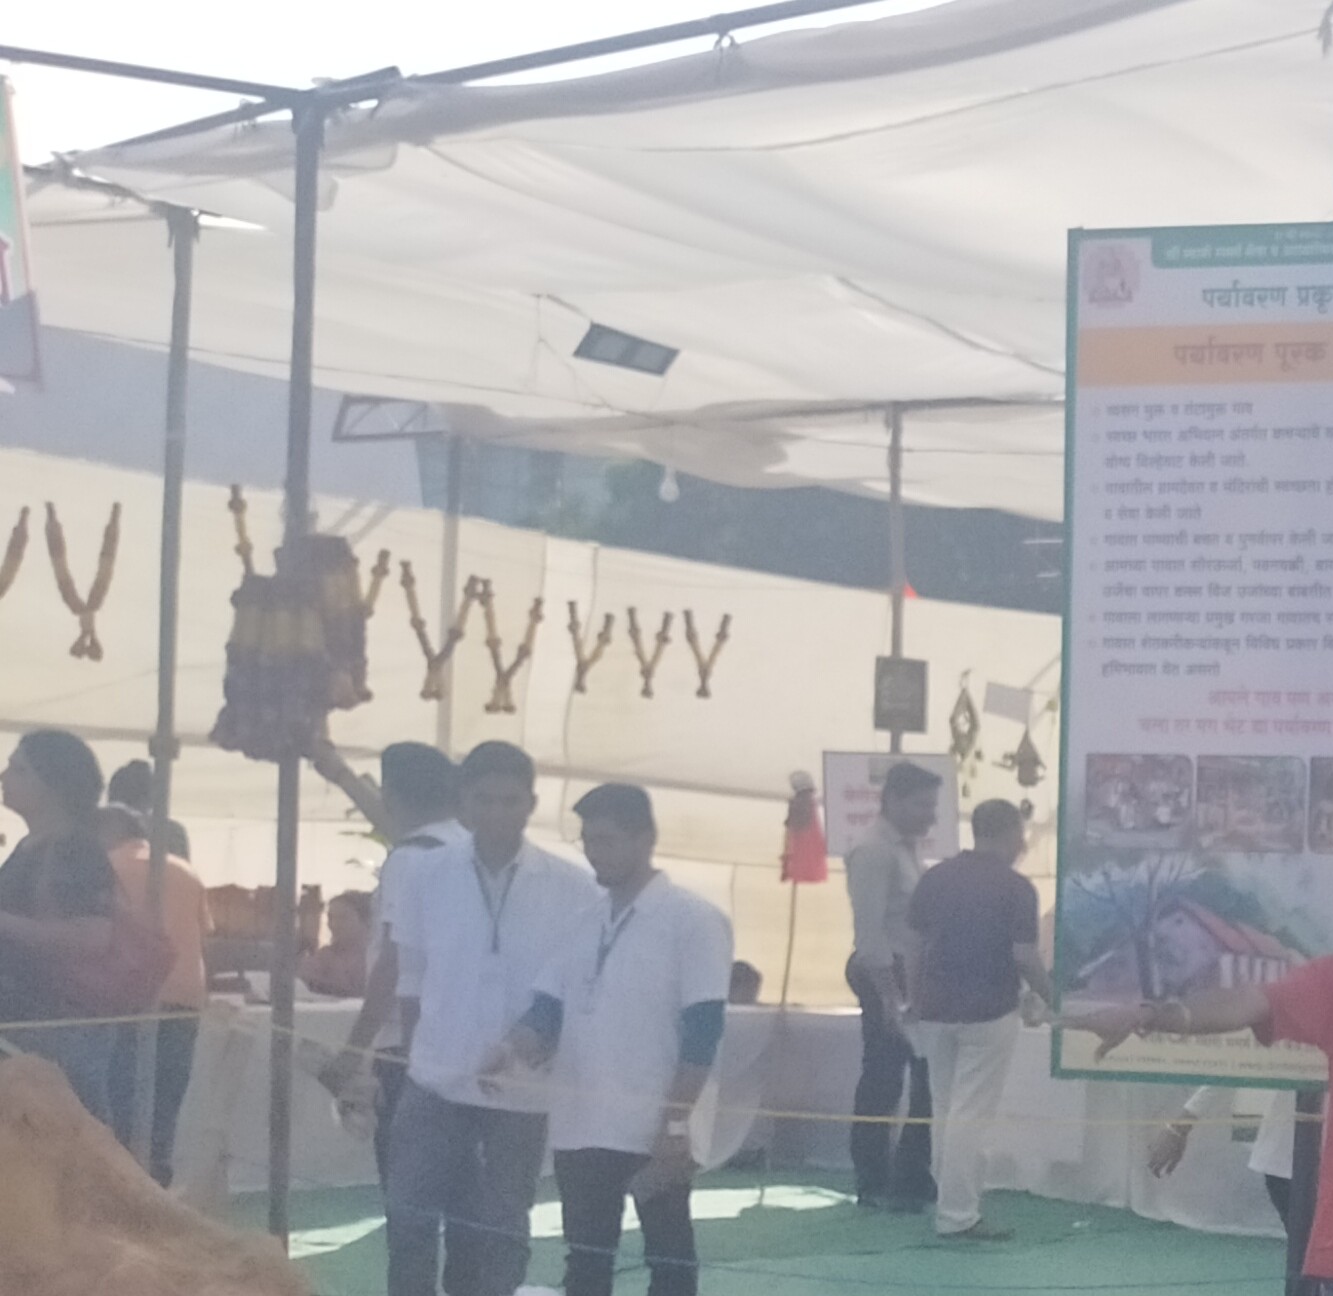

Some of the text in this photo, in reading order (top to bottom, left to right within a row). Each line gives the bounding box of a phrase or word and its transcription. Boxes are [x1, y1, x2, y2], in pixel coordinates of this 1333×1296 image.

[1202, 279, 1288, 308] पर्यावरण
[1173, 336, 1265, 367] पर्यावरण
[1274, 342, 1327, 373] पूरक
